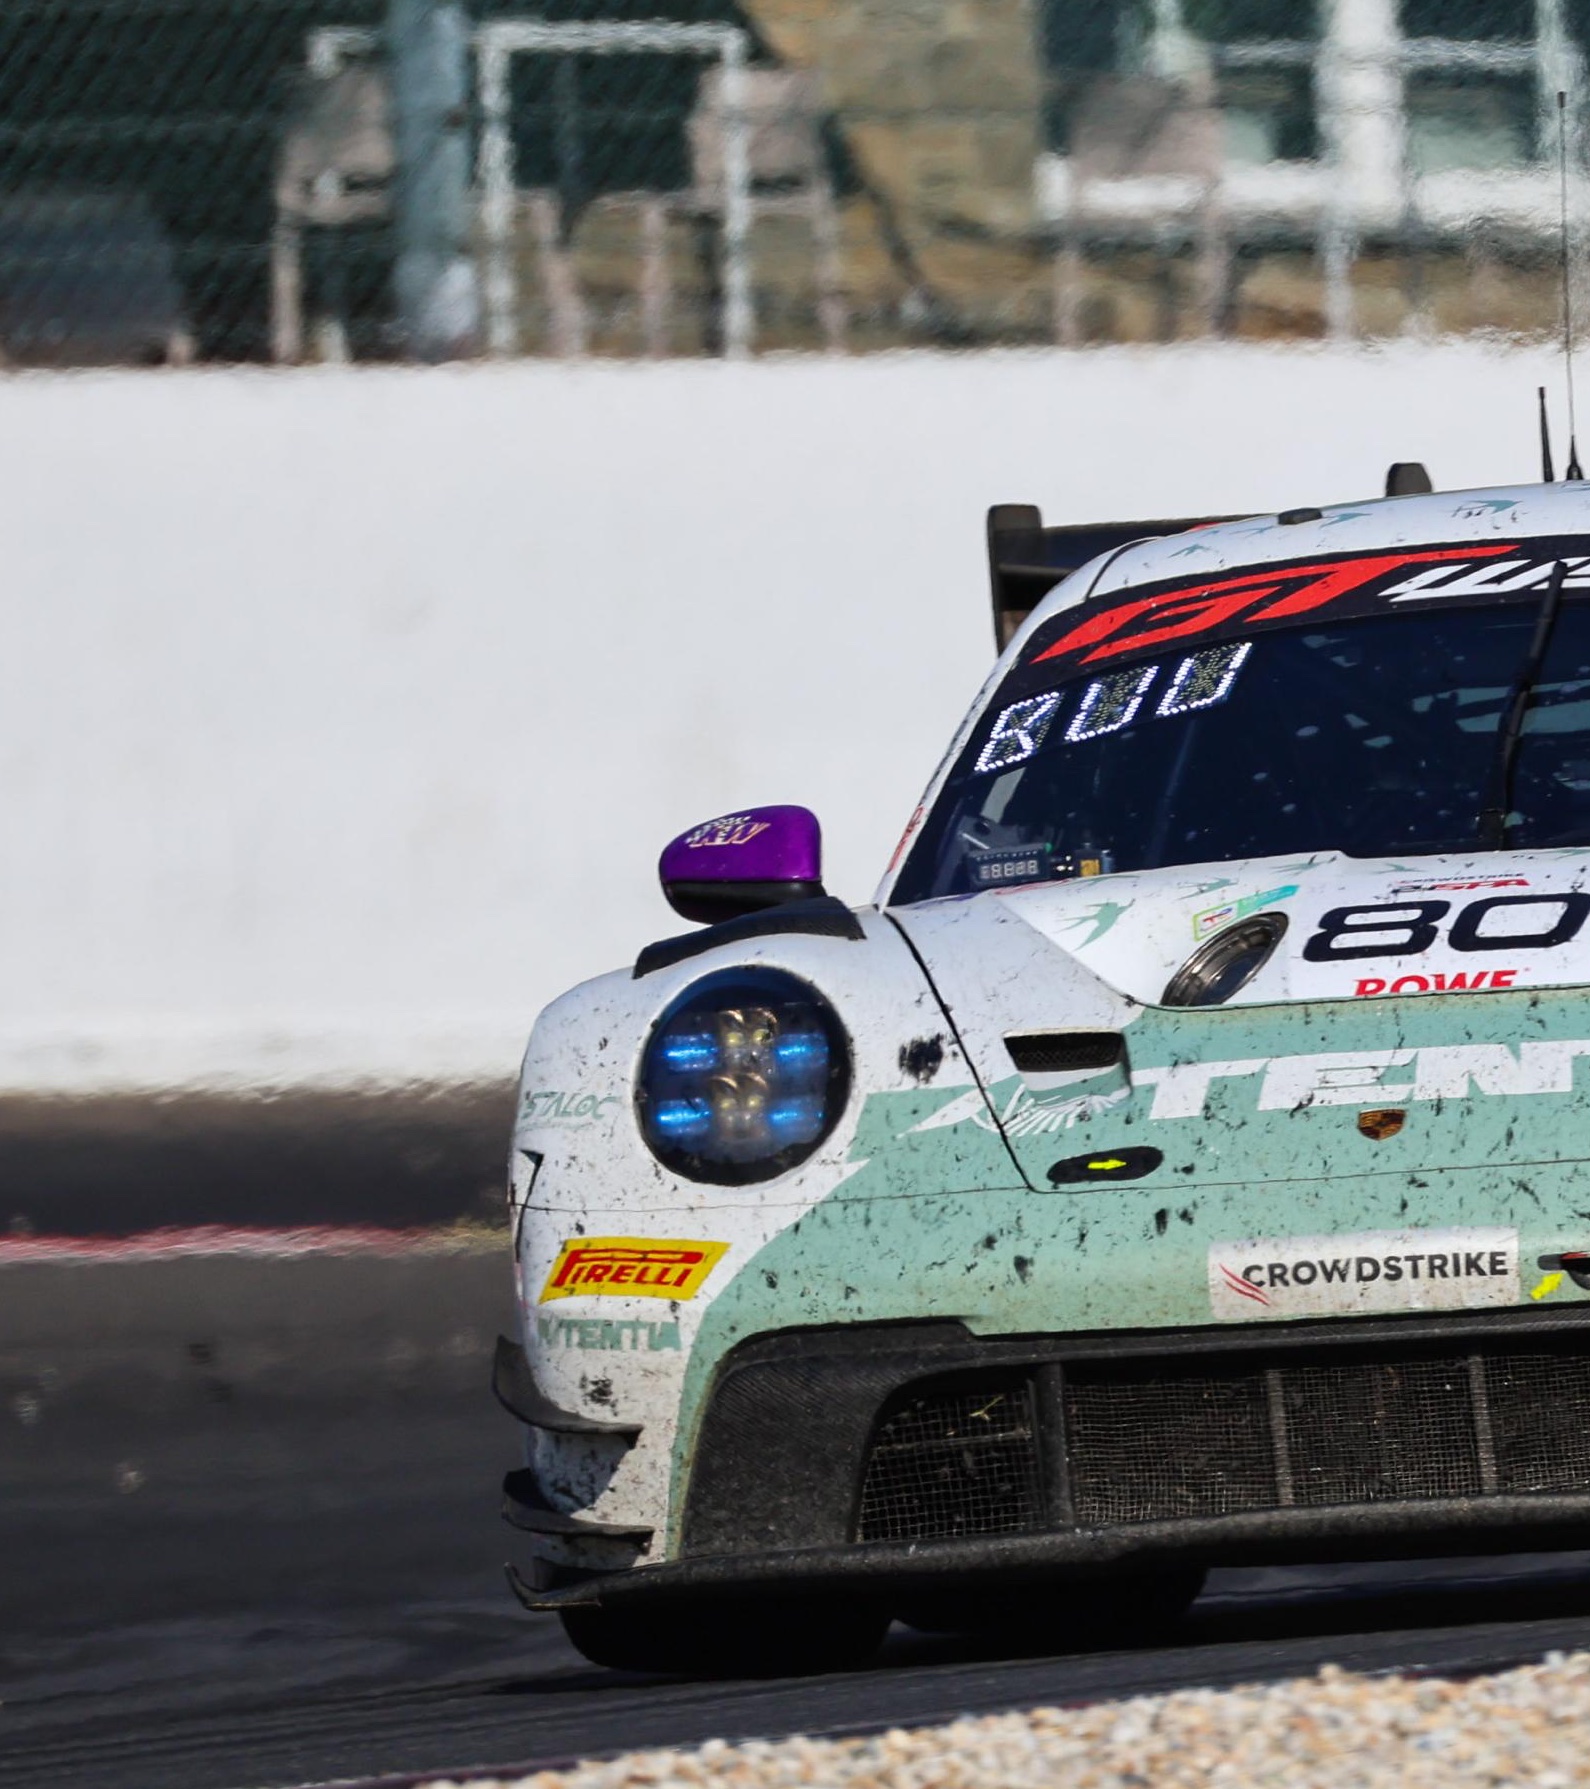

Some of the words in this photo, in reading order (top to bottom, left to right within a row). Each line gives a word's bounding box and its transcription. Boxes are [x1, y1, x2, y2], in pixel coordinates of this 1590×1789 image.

[1030, 546, 1519, 664] GT
[1355, 970, 1518, 997] ROWE
[551, 1248, 705, 1288] PIRELLI
[1241, 1250, 1509, 1288] CROWDSTRIKE
